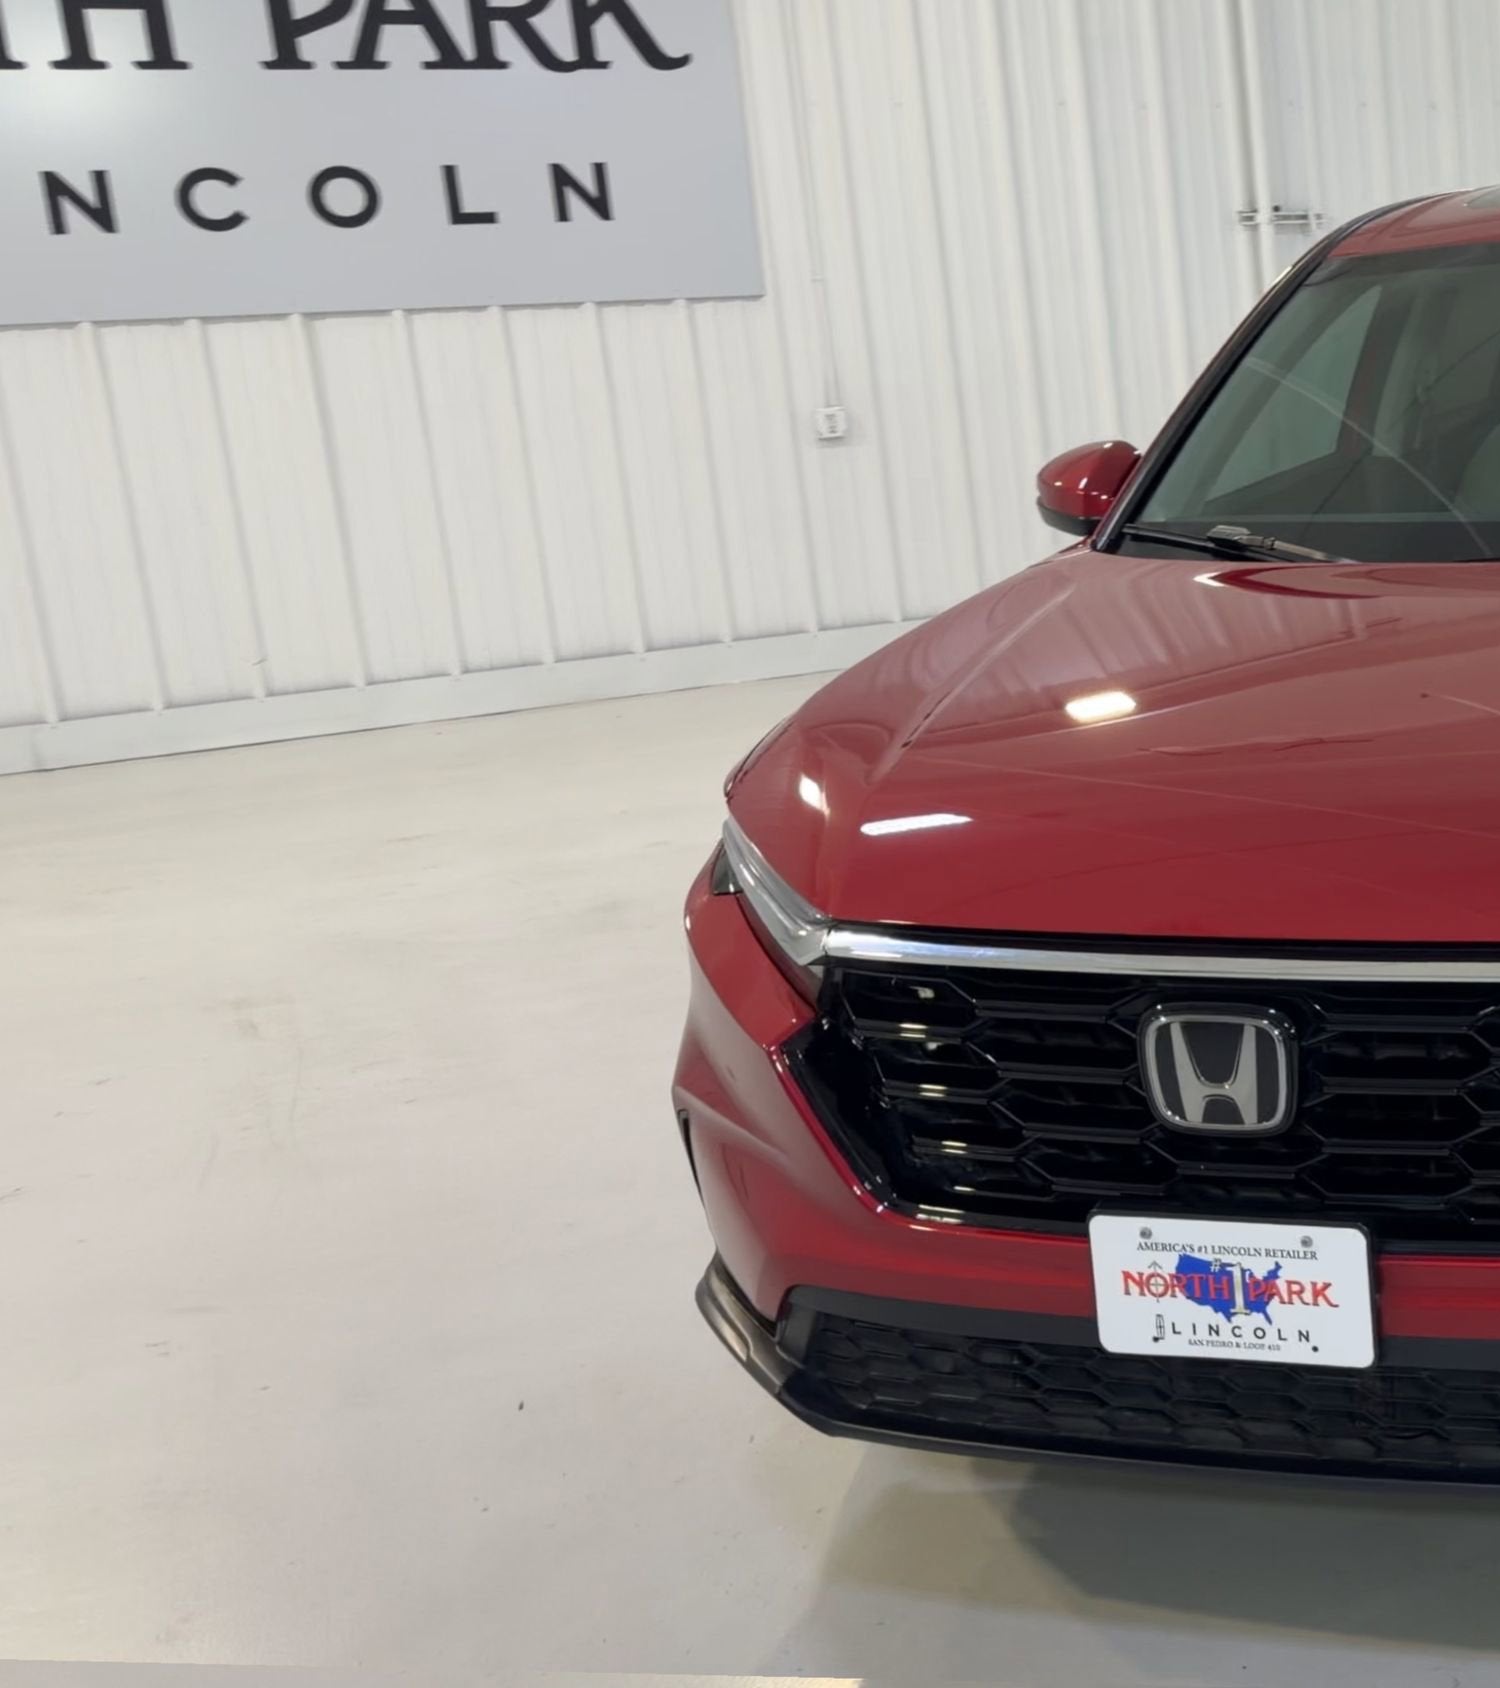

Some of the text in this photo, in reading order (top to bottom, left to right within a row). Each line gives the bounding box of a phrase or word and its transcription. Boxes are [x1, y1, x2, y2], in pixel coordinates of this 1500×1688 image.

[38, 162, 615, 235] NCOLN
[1136, 1241, 1319, 1261] AMERICA'S #1 LINCOLN RETAILER
[1121, 1269, 1340, 1308] NORTH PARK
[1171, 1321, 1311, 1343] LINCOLN
[1187, 1338, 1205, 1347] SAN
[1206, 1340, 1234, 1349] PEDRO
